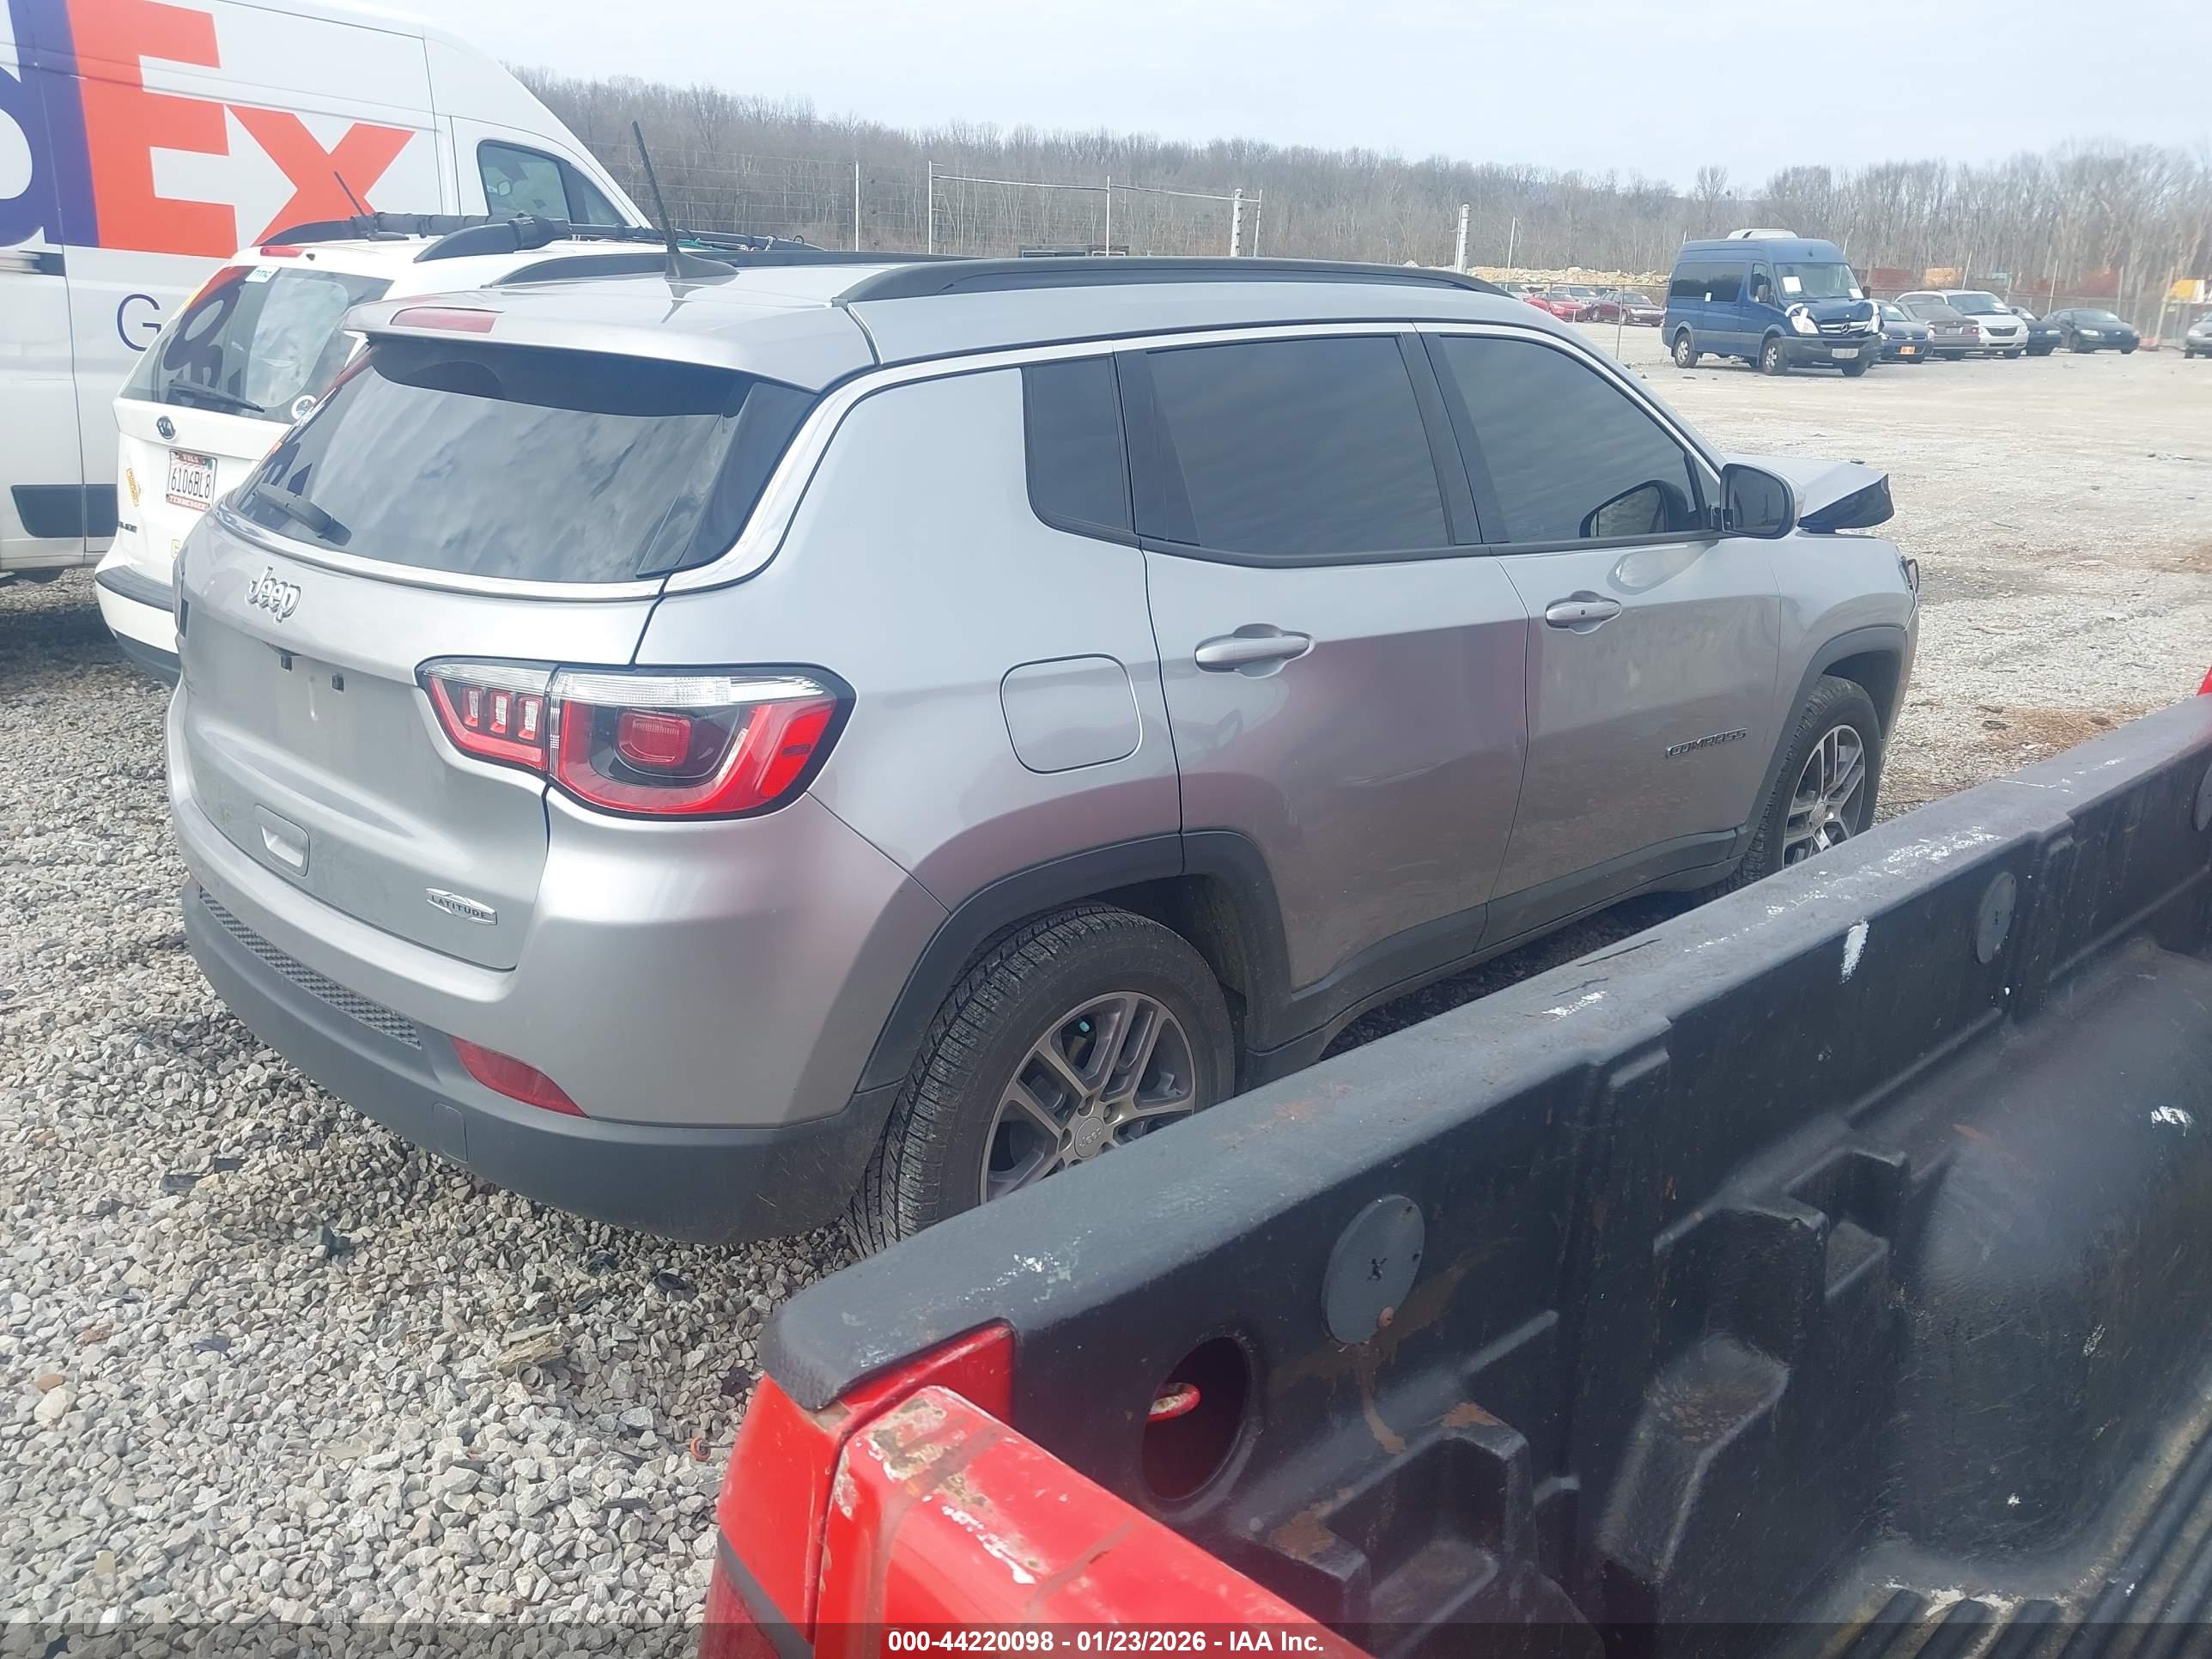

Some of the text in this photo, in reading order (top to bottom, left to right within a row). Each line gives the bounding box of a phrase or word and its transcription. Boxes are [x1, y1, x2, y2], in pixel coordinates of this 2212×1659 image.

[171, 467, 211, 499] 6106BL8
[246, 566, 301, 623] Jeep
[1664, 727, 1748, 758] COMPASS
[431, 895, 488, 920] LATITUDE
